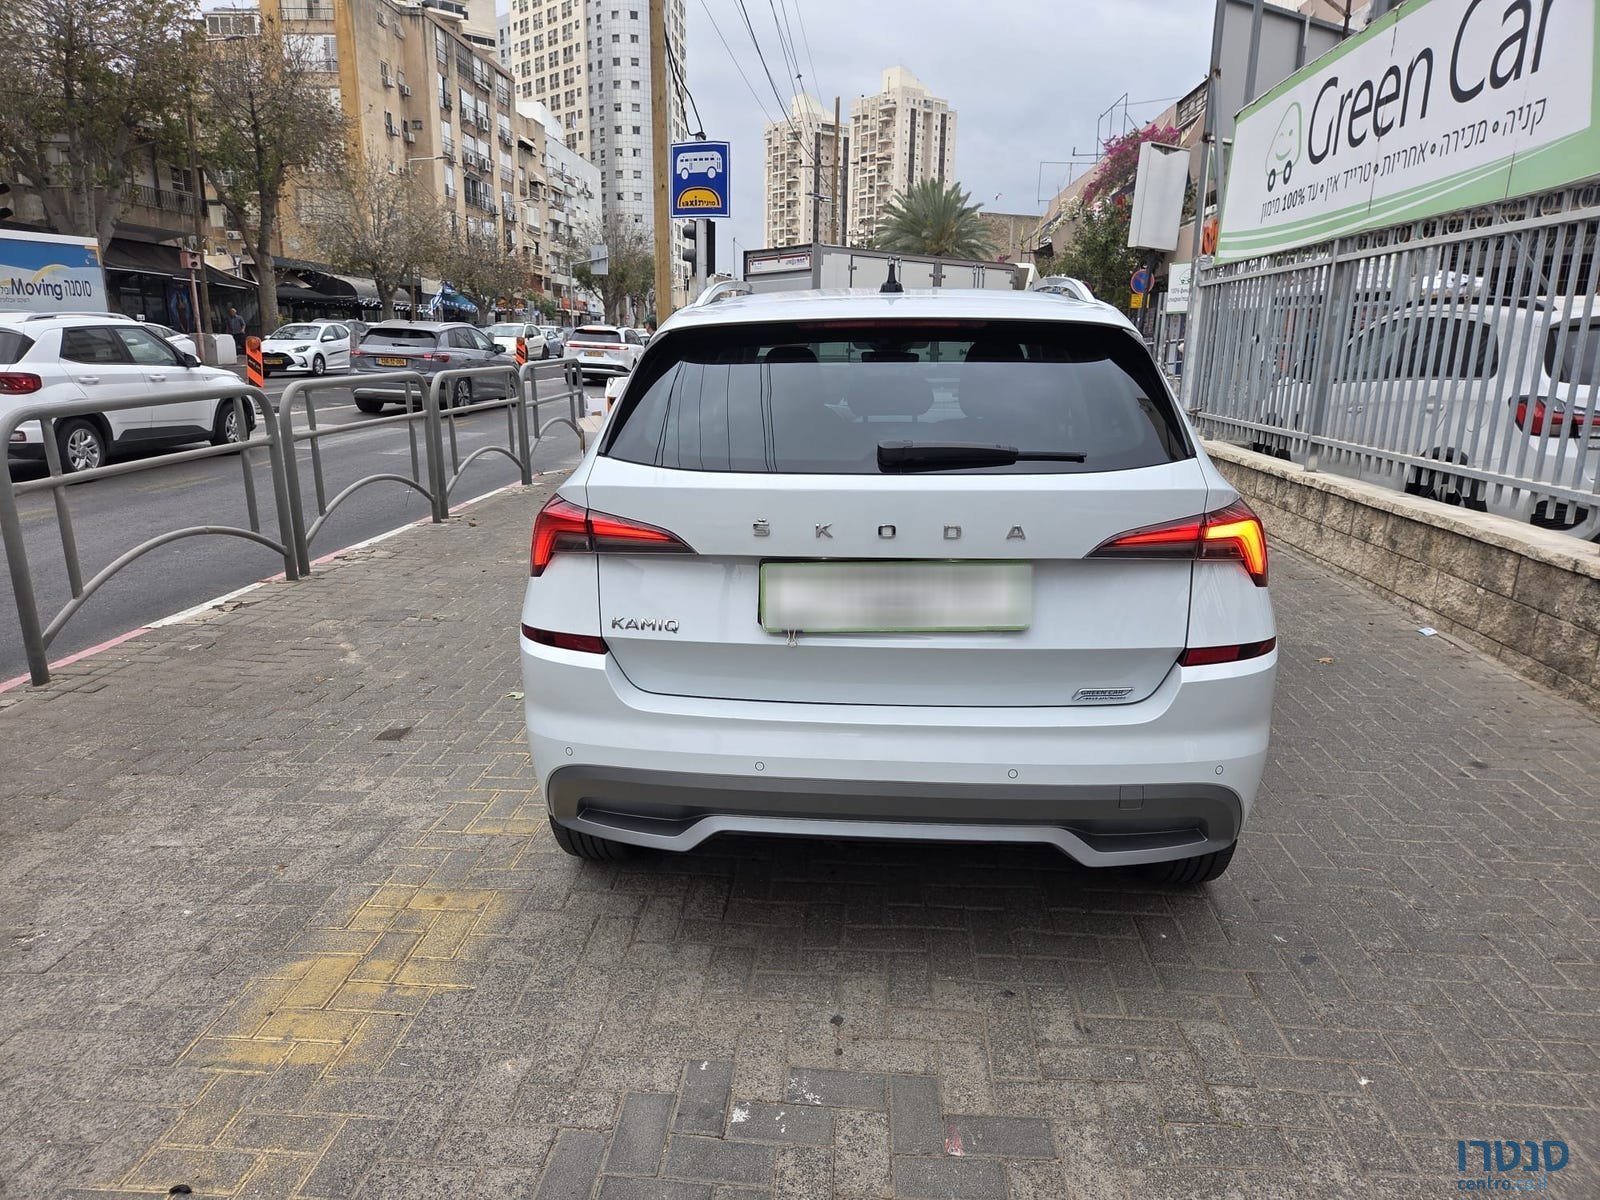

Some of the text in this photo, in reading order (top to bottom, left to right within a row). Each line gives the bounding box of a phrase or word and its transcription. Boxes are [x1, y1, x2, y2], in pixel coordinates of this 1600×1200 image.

[1308, 0, 1553, 164] Green Car
[1260, 98, 1547, 224] קניה מכירה אחריות טרייד אין עד 100% מימון
[11, 277, 63, 300] Moving
[611, 617, 679, 633] KAMIQ
